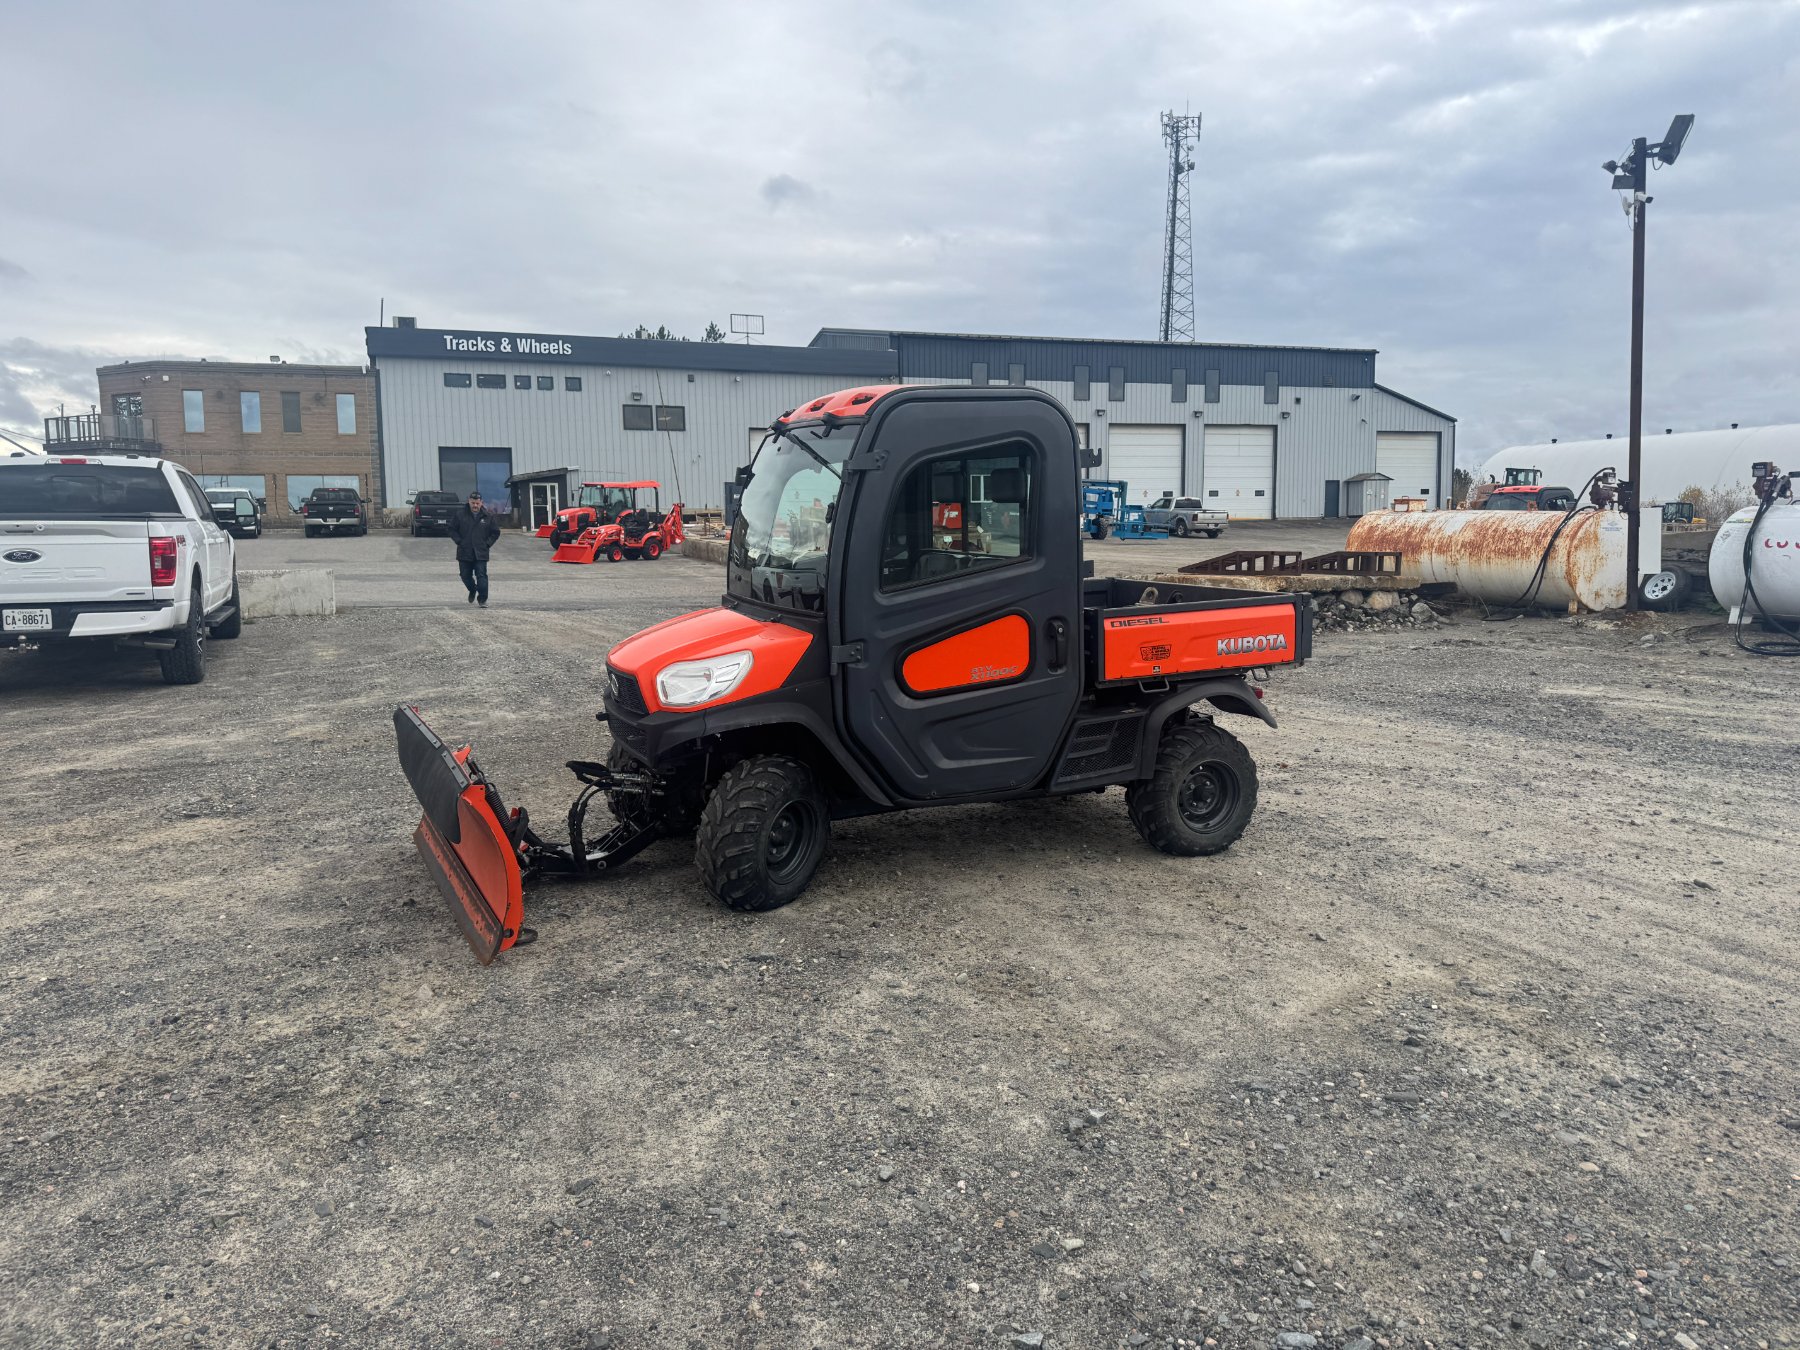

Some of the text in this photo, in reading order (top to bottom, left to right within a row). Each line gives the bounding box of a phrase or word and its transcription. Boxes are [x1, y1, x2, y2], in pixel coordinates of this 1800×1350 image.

[443, 335, 572, 354] Tracks & Wheels
[1110, 617, 1170, 628] DIESEL
[1216, 634, 1287, 656] KUBOTA
